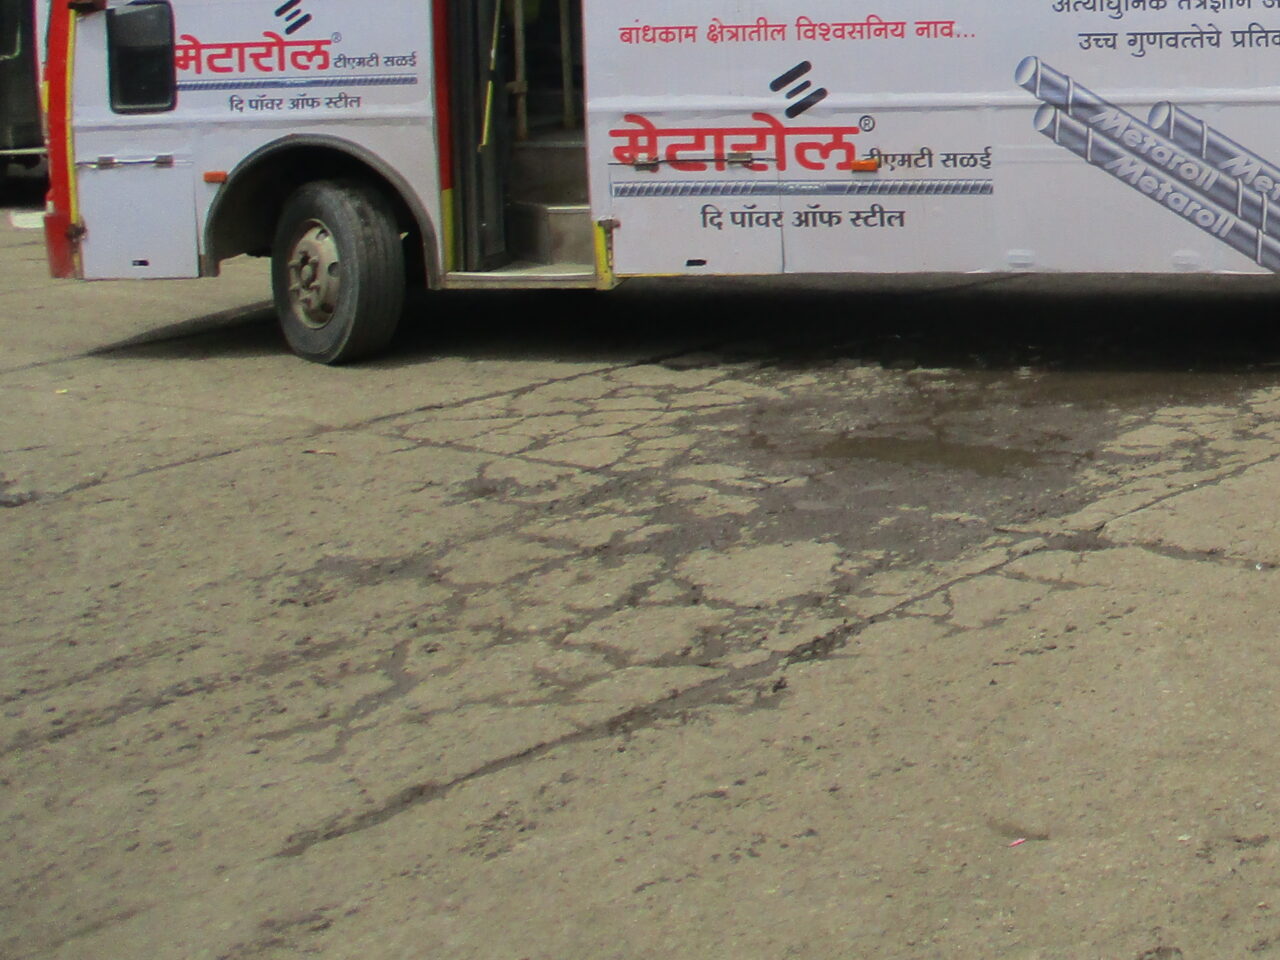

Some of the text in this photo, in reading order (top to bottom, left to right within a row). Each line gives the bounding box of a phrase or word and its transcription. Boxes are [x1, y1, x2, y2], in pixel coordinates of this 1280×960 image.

[619, 19, 698, 44] बांधकाम
[706, 17, 787, 43] क्षेत्रातील
[795, 14, 907, 41] विश्वसनिय
[1078, 32, 1118, 51] उच्च
[229, 92, 361, 112] दि पॉवर ऑफ स्टील
[1089, 109, 1219, 191] Metaroll
[1104, 154, 1236, 238] Metaroll
[701, 204, 905, 231] दि पॉवर ऑफ स्टील
